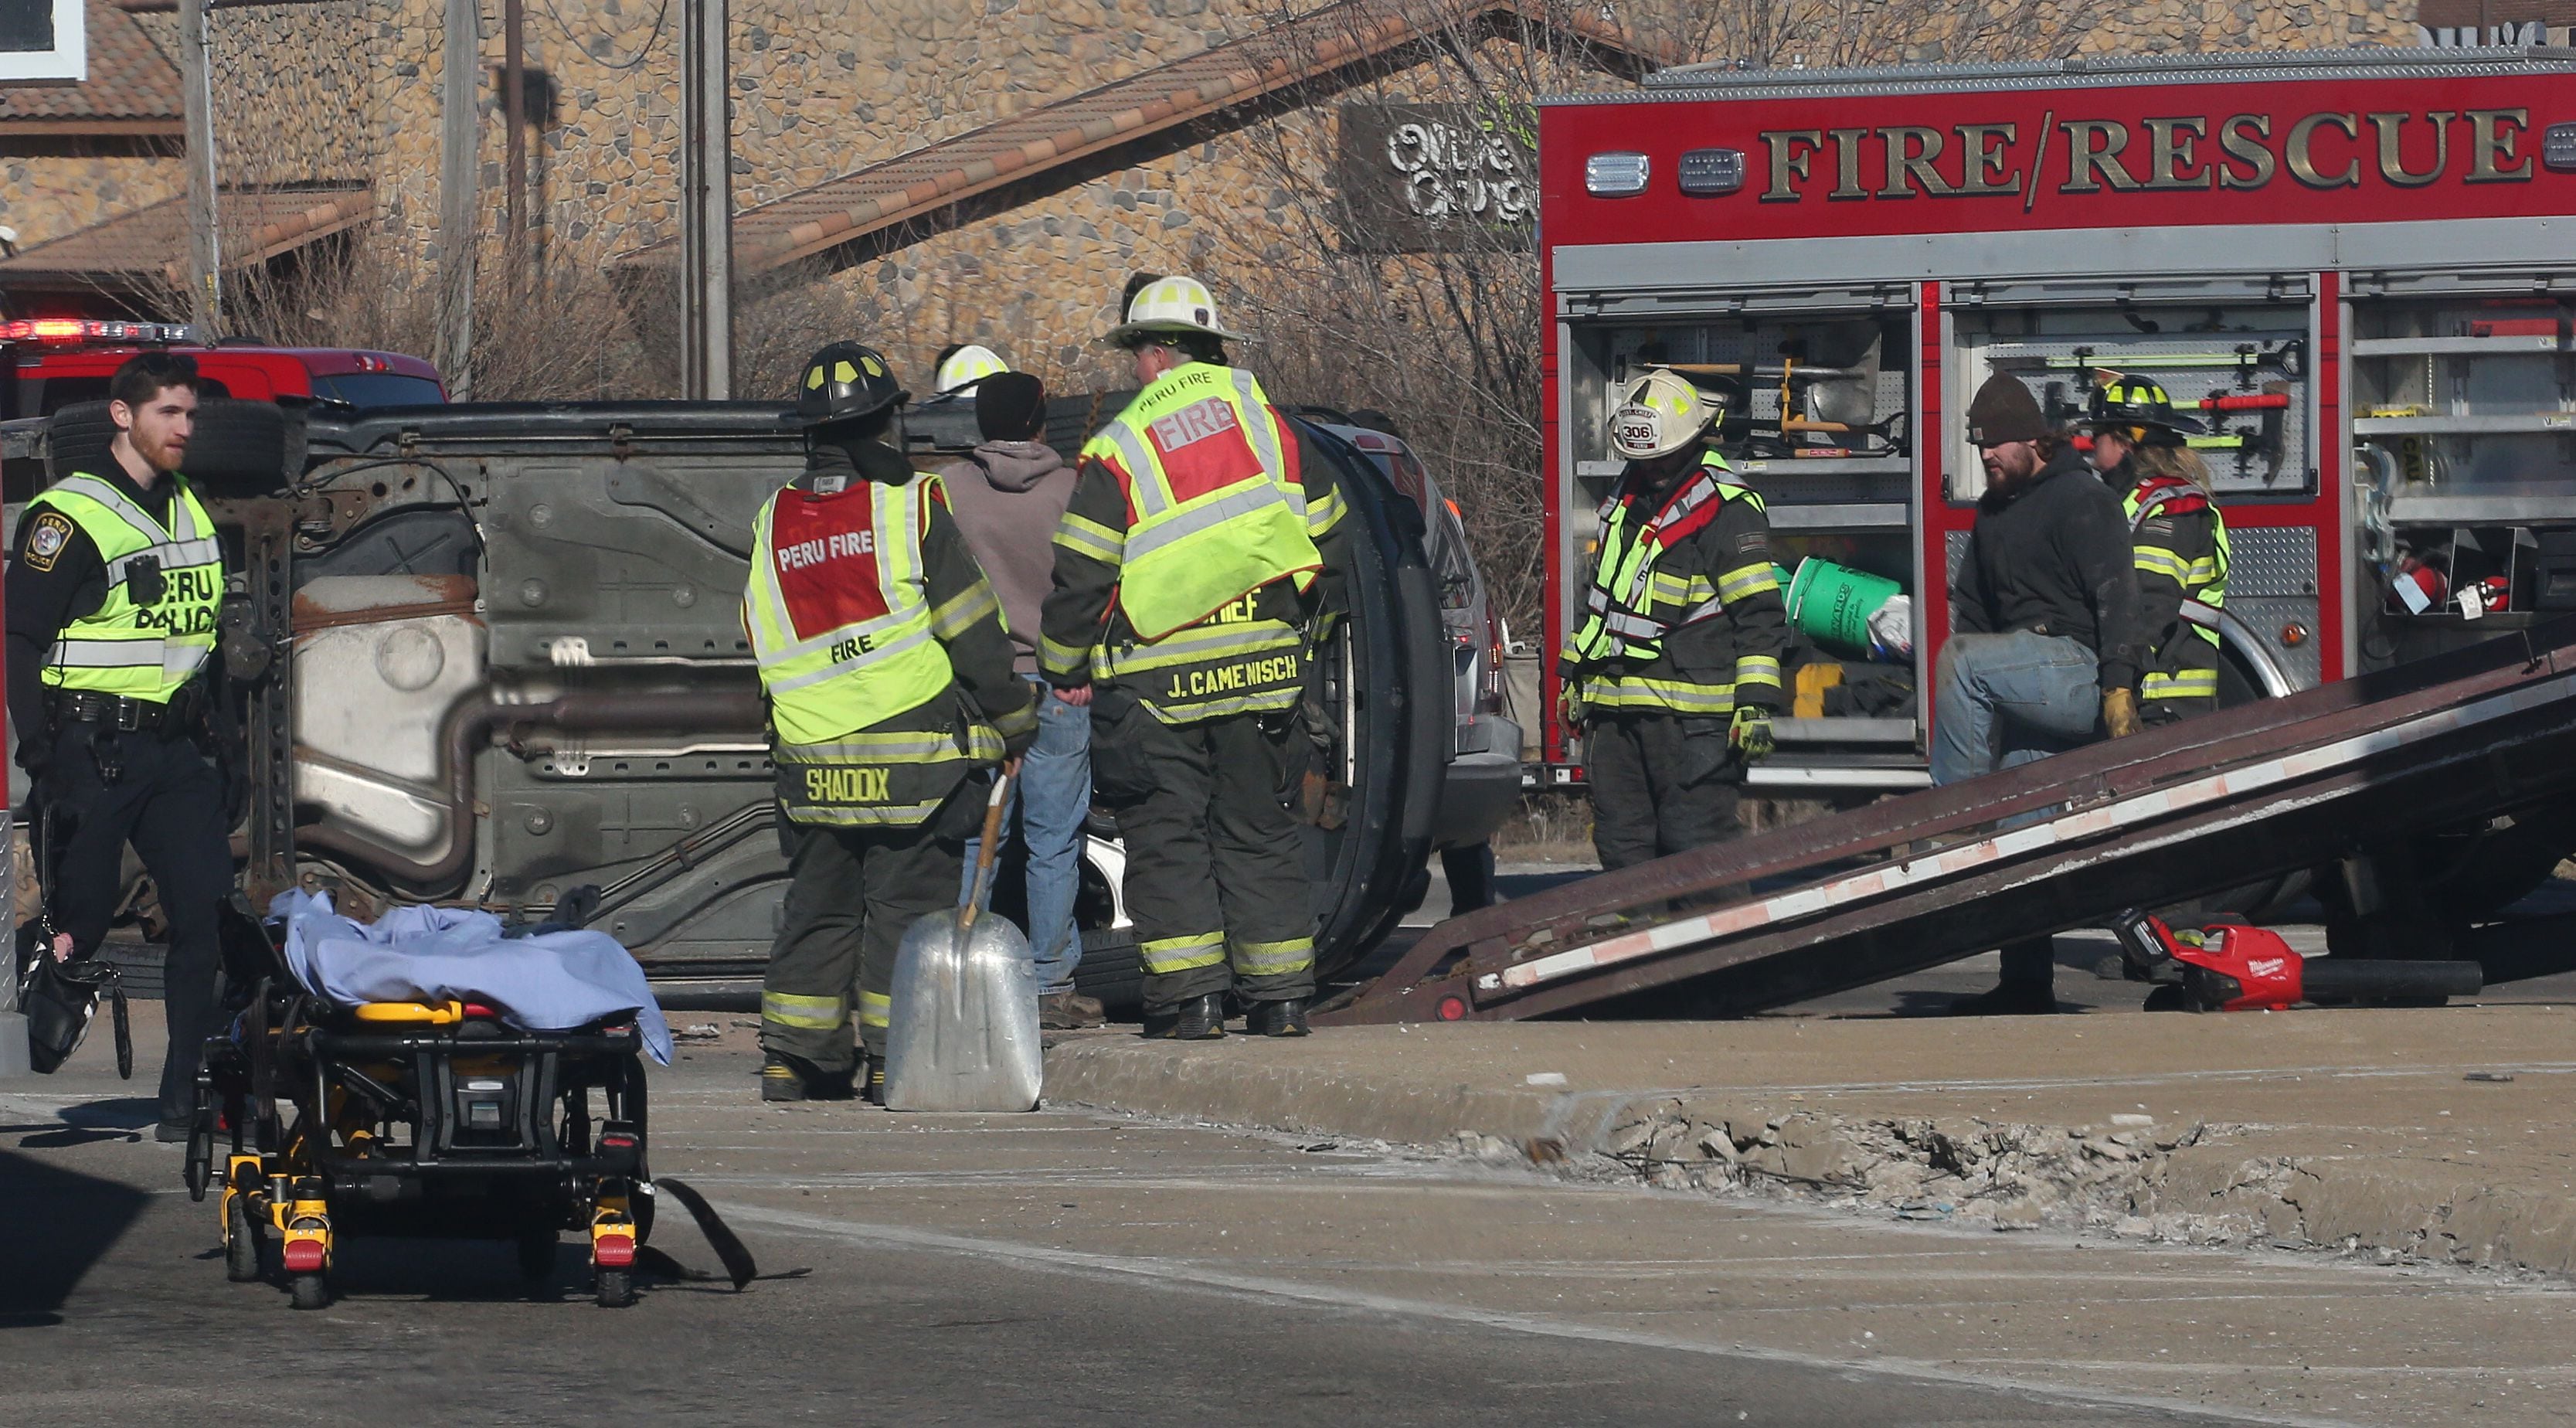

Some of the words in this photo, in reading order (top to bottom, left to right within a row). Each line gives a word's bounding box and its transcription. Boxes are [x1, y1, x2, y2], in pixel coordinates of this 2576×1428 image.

[1759, 107, 2534, 213] FIRE/RESCUE
[1139, 384, 1177, 413] PERU
[1178, 371, 1212, 389] FIRE
[1154, 397, 1233, 450] FIRE
[1623, 426, 1650, 438] 306
[42, 517, 67, 533] PERU
[777, 539, 826, 572] PERU
[828, 529, 874, 559] FIRE
[831, 634, 875, 665] FIRE
[1167, 674, 1188, 698] J.
[1190, 654, 1297, 695] CAMENISCH
